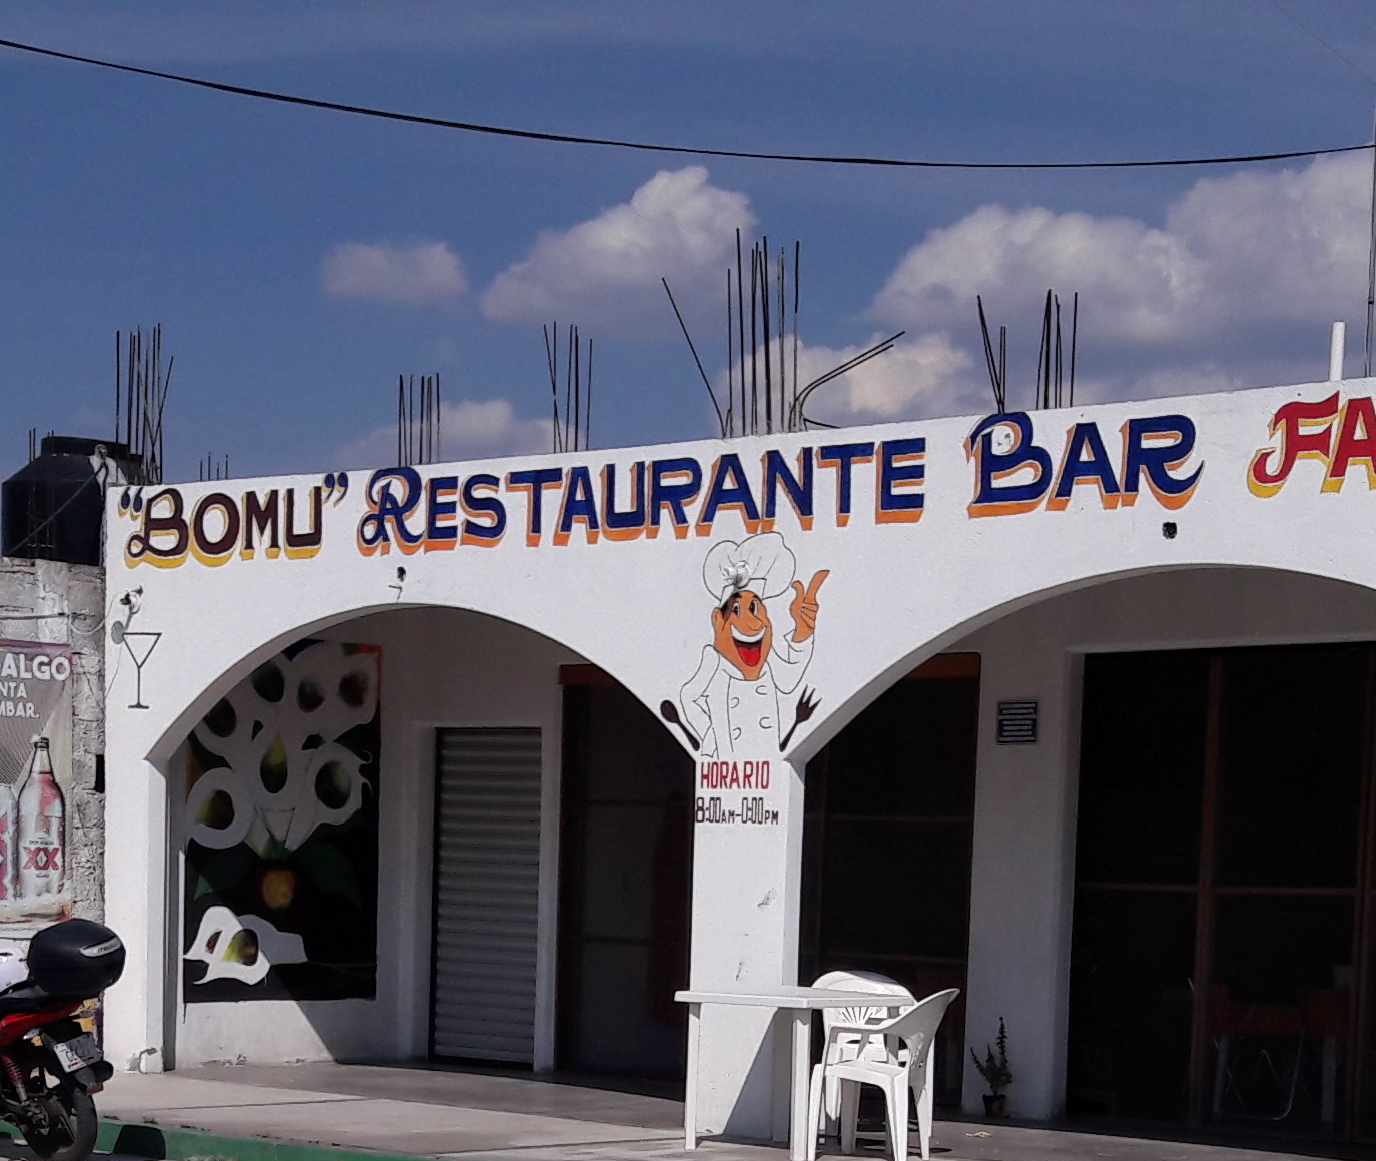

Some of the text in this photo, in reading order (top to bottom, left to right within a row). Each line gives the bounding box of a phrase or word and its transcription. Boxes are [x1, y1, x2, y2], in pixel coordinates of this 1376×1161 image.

[357, 438, 926, 556] RESTAURANTE
[964, 411, 1204, 519] BAR
[700, 760, 770, 789] HORARIO
